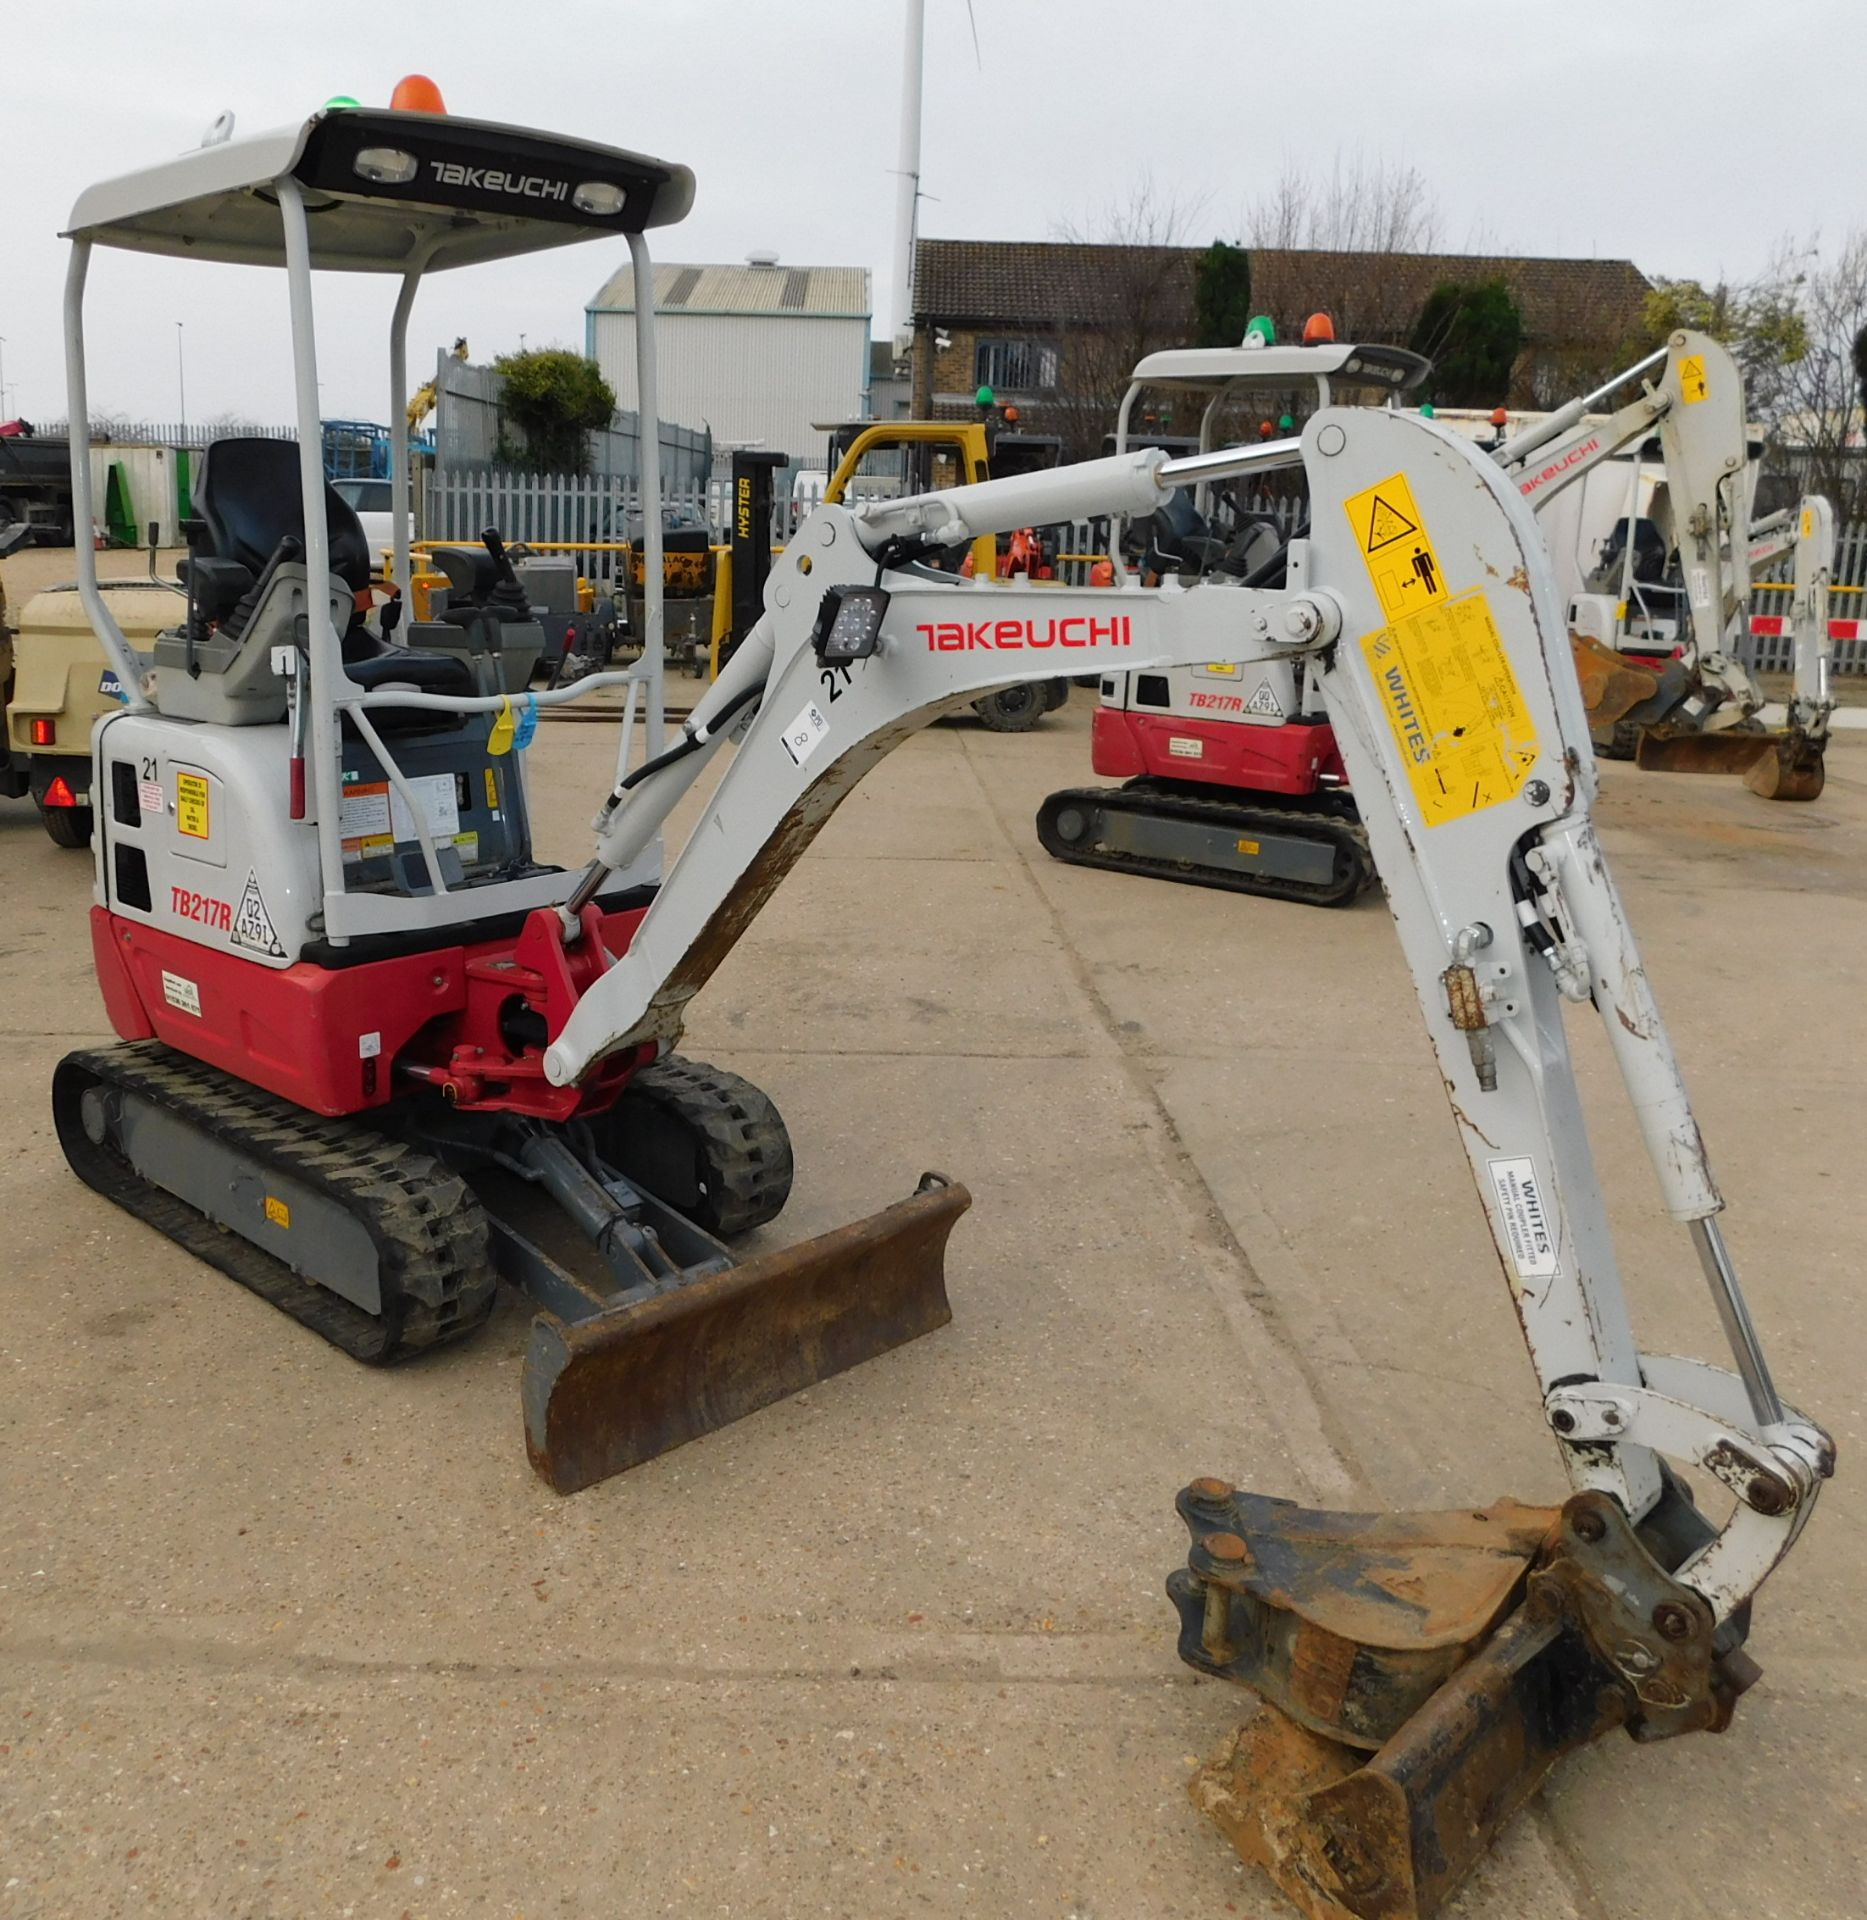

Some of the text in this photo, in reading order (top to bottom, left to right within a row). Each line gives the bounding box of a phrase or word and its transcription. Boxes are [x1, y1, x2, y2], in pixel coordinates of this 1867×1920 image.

[430, 161, 569, 201] TAKEUCHI
[1520, 439, 1600, 496] AKEUCHI
[738, 477, 751, 539] HYSTER
[916, 616, 1130, 652] TAKEUCHI
[1189, 692, 1243, 712] TB217R
[1385, 665, 1431, 764] WHITES
[1499, 684, 1516, 718] CAUTION
[142, 756, 158, 782] 21
[171, 886, 231, 932] TB217R
[1498, 1178, 1526, 1260] SAFETY PIN REQUIRED
[1507, 1171, 1537, 1266] MANUAL COUPLER FITTED
[1522, 1180, 1550, 1254] WHITES
